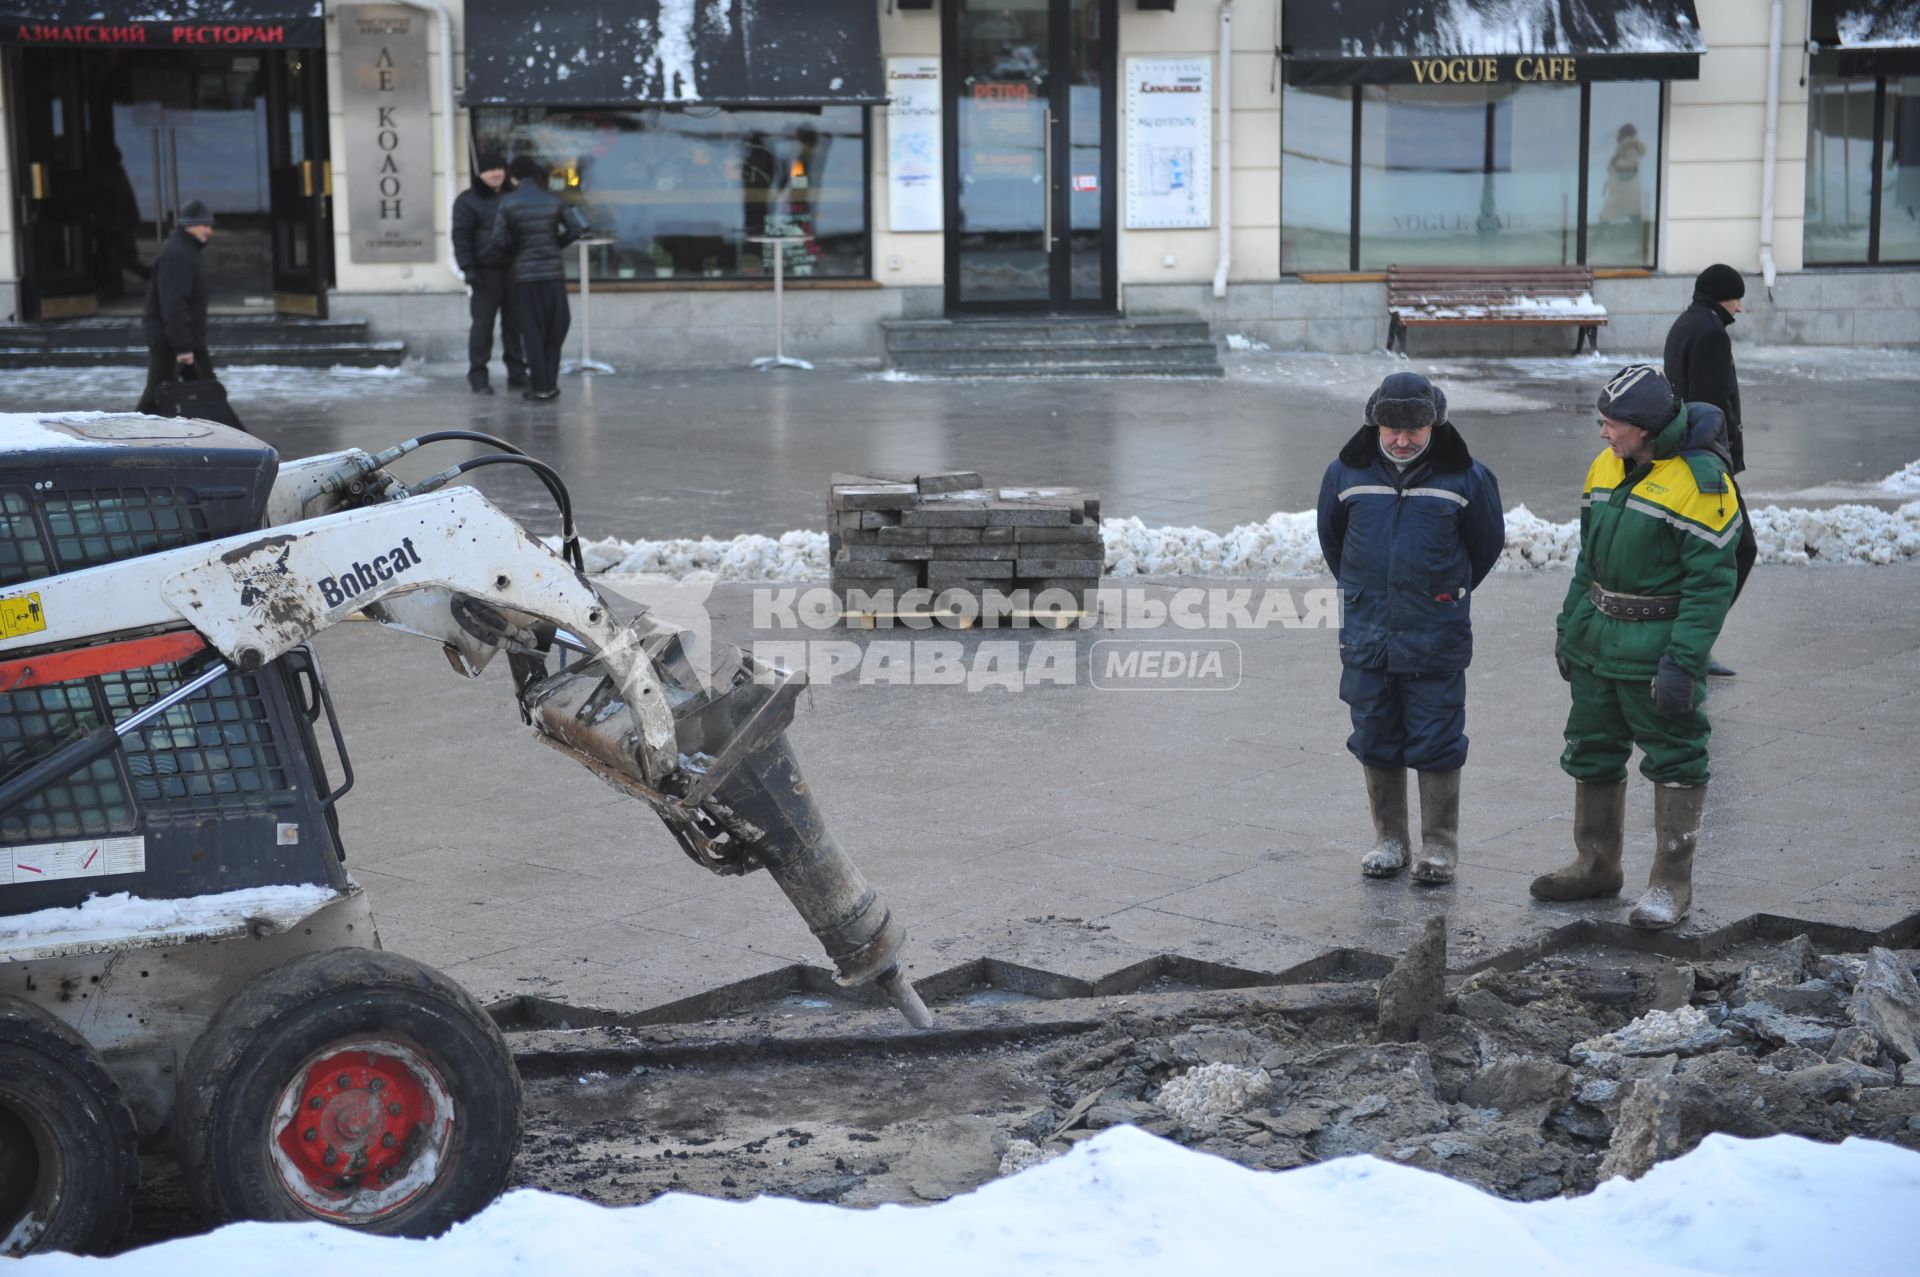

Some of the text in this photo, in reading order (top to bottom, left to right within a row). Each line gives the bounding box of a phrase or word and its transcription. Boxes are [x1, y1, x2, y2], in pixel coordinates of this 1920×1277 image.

[16, 23, 284, 44] АЗИАТСКИЙ РЕСТОРАН
[1411, 56, 1577, 84] VOGUE CAFE
[376, 106, 403, 220] КОЛОН
[317, 537, 421, 608] Bobcat
